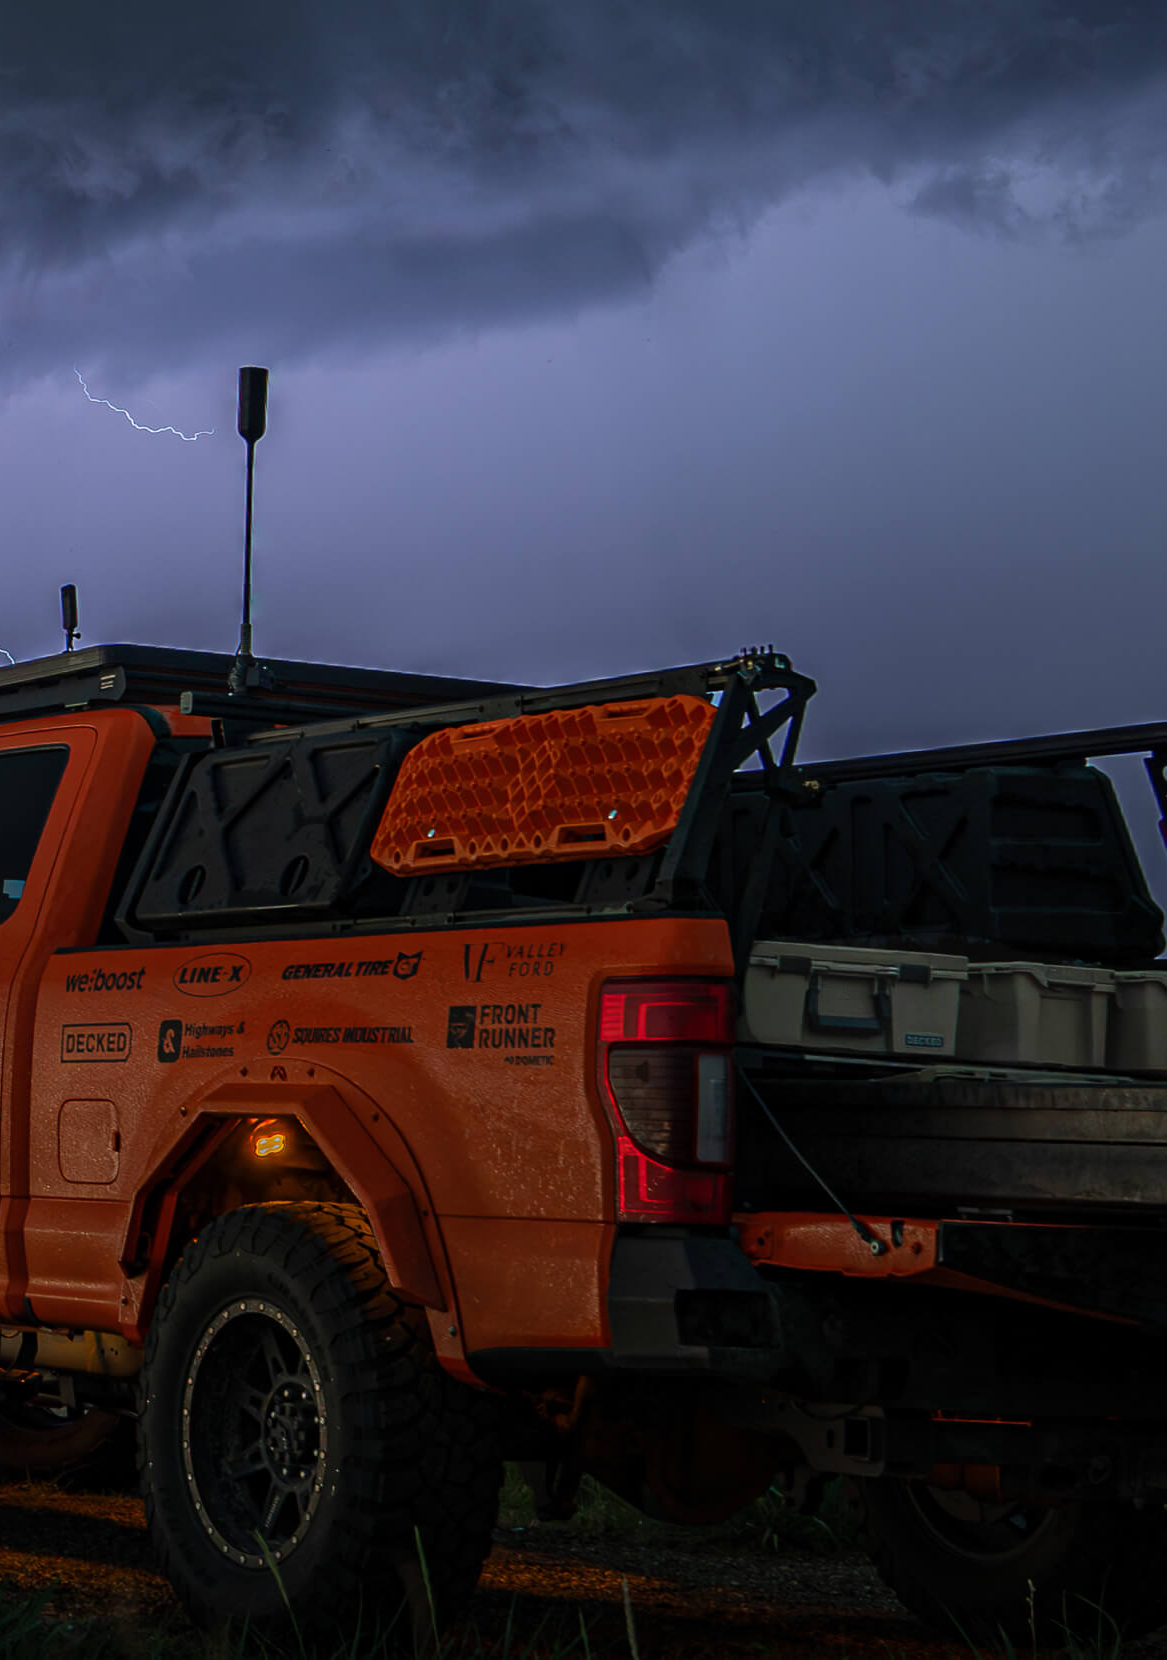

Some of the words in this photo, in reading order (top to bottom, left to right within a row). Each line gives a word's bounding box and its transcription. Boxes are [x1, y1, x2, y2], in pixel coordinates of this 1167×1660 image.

[506, 942, 566, 959] VALLEY
[179, 966, 244, 984] LINE-X
[282, 962, 354, 980] GENERAL
[355, 960, 394, 976] TIRE
[508, 961, 554, 977] FORD
[479, 1003, 542, 1025] FRONT
[66, 1032, 127, 1053] DECKED
[478, 1027, 556, 1049] RUNNER
